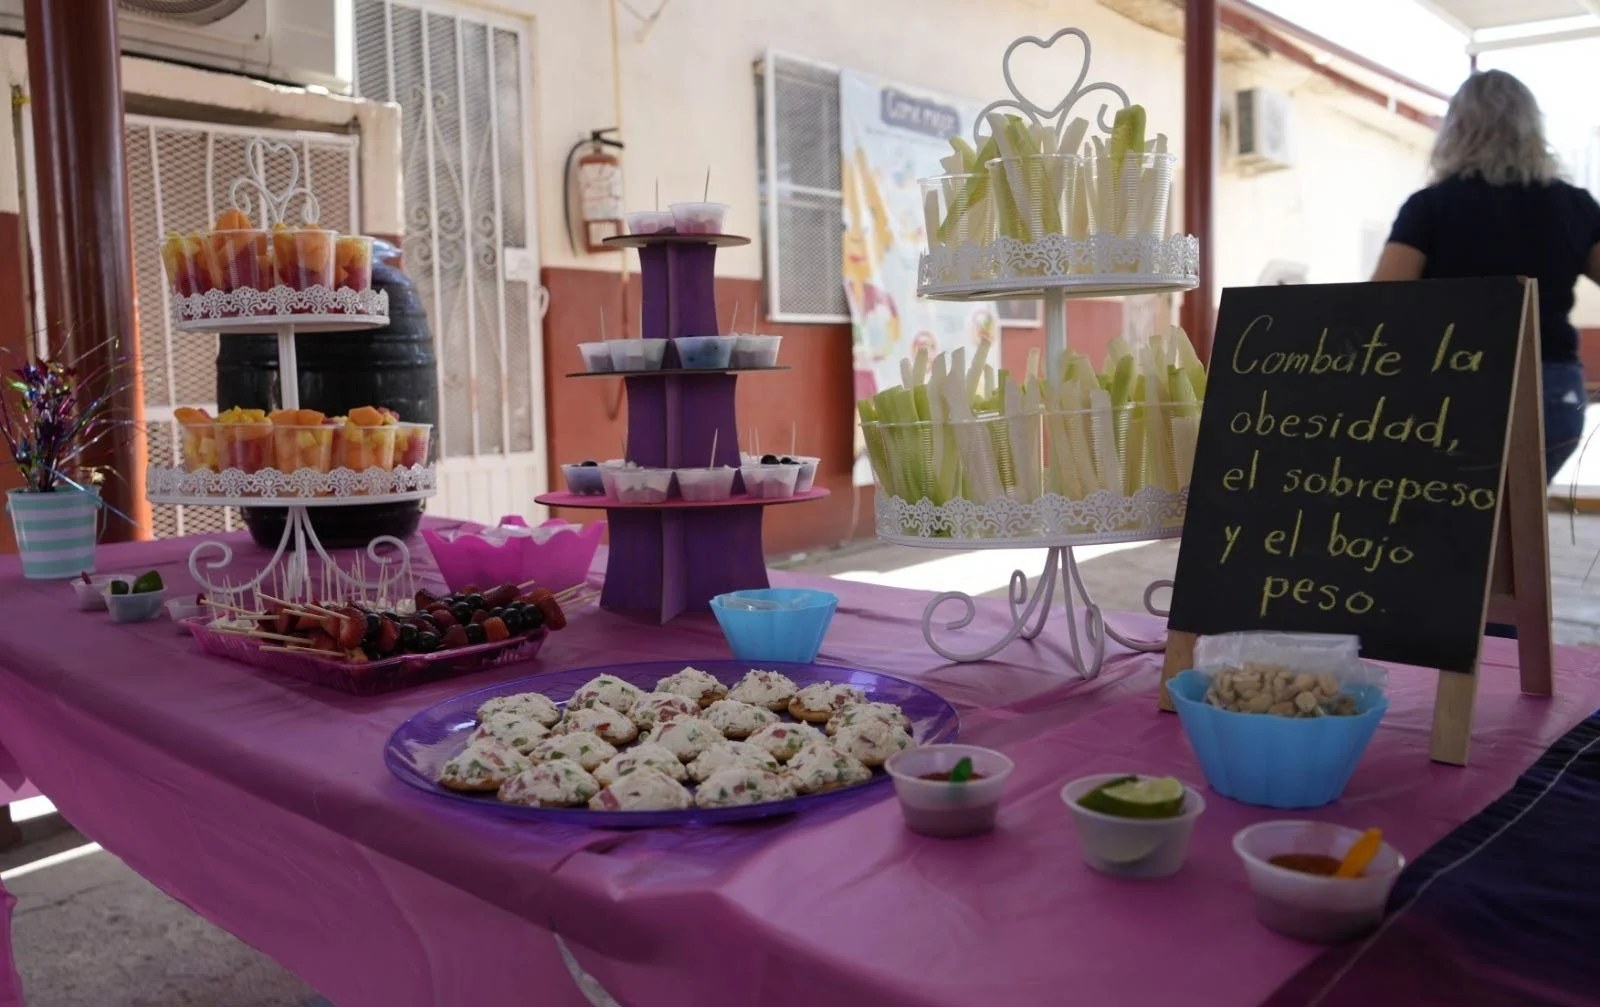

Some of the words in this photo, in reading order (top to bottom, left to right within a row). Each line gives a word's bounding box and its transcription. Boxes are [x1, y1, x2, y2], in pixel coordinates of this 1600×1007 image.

[1231, 315, 1402, 376] Combate
[1431, 322, 1484, 374] la
[1230, 390, 1460, 454] obesidad,
[1222, 449, 1259, 491] el
[1283, 456, 1496, 524] sobrepeso
[1220, 524, 1242, 564] y
[1264, 509, 1303, 557] el
[1327, 512, 1414, 572] bajo
[1260, 575, 1386, 617] peso.
